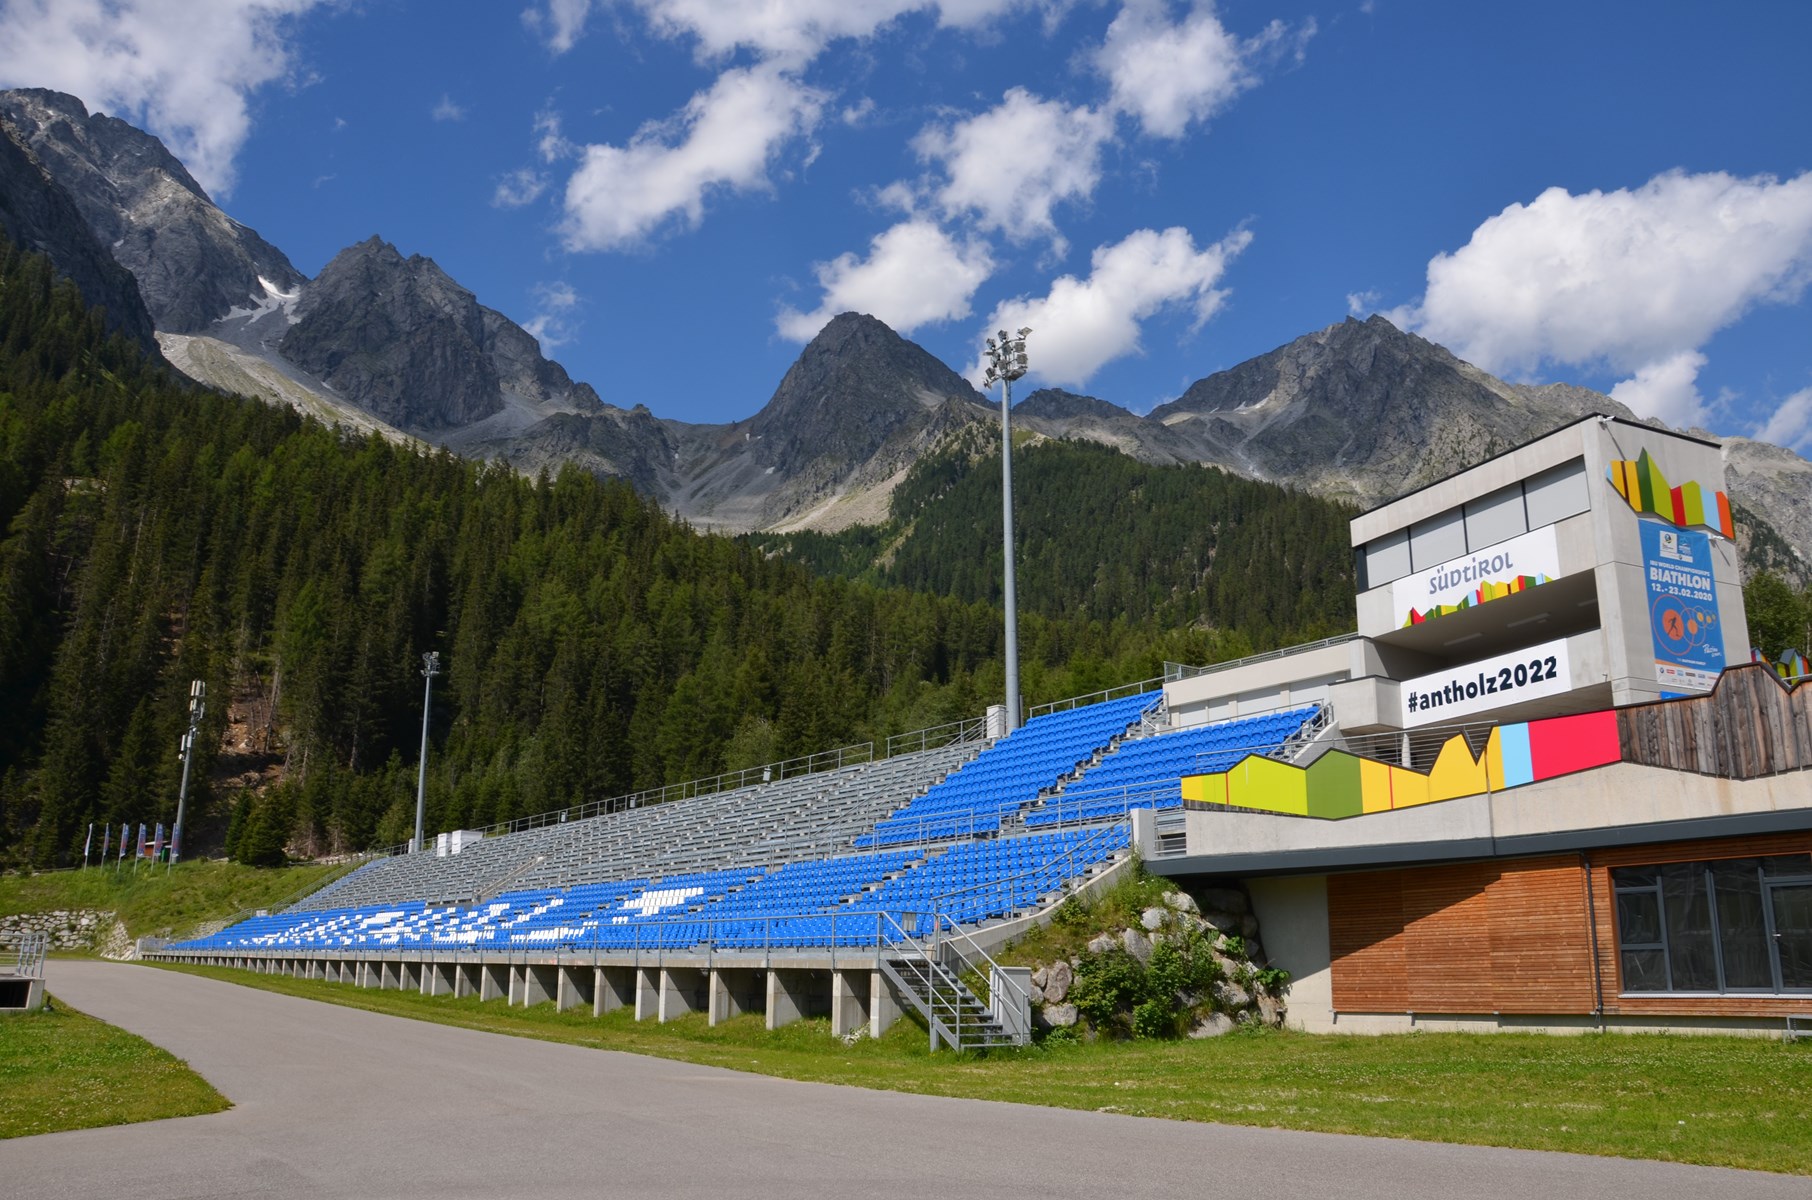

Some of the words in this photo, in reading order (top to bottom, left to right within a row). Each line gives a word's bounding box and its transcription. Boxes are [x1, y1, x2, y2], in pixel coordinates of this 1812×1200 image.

[1650, 566, 1710, 591] BIATHLON
[1659, 561, 1675, 570] WORLD
[1675, 565, 1710, 576] CHAMPIONSHIPS
[1408, 655, 1557, 713] #antholz2022
